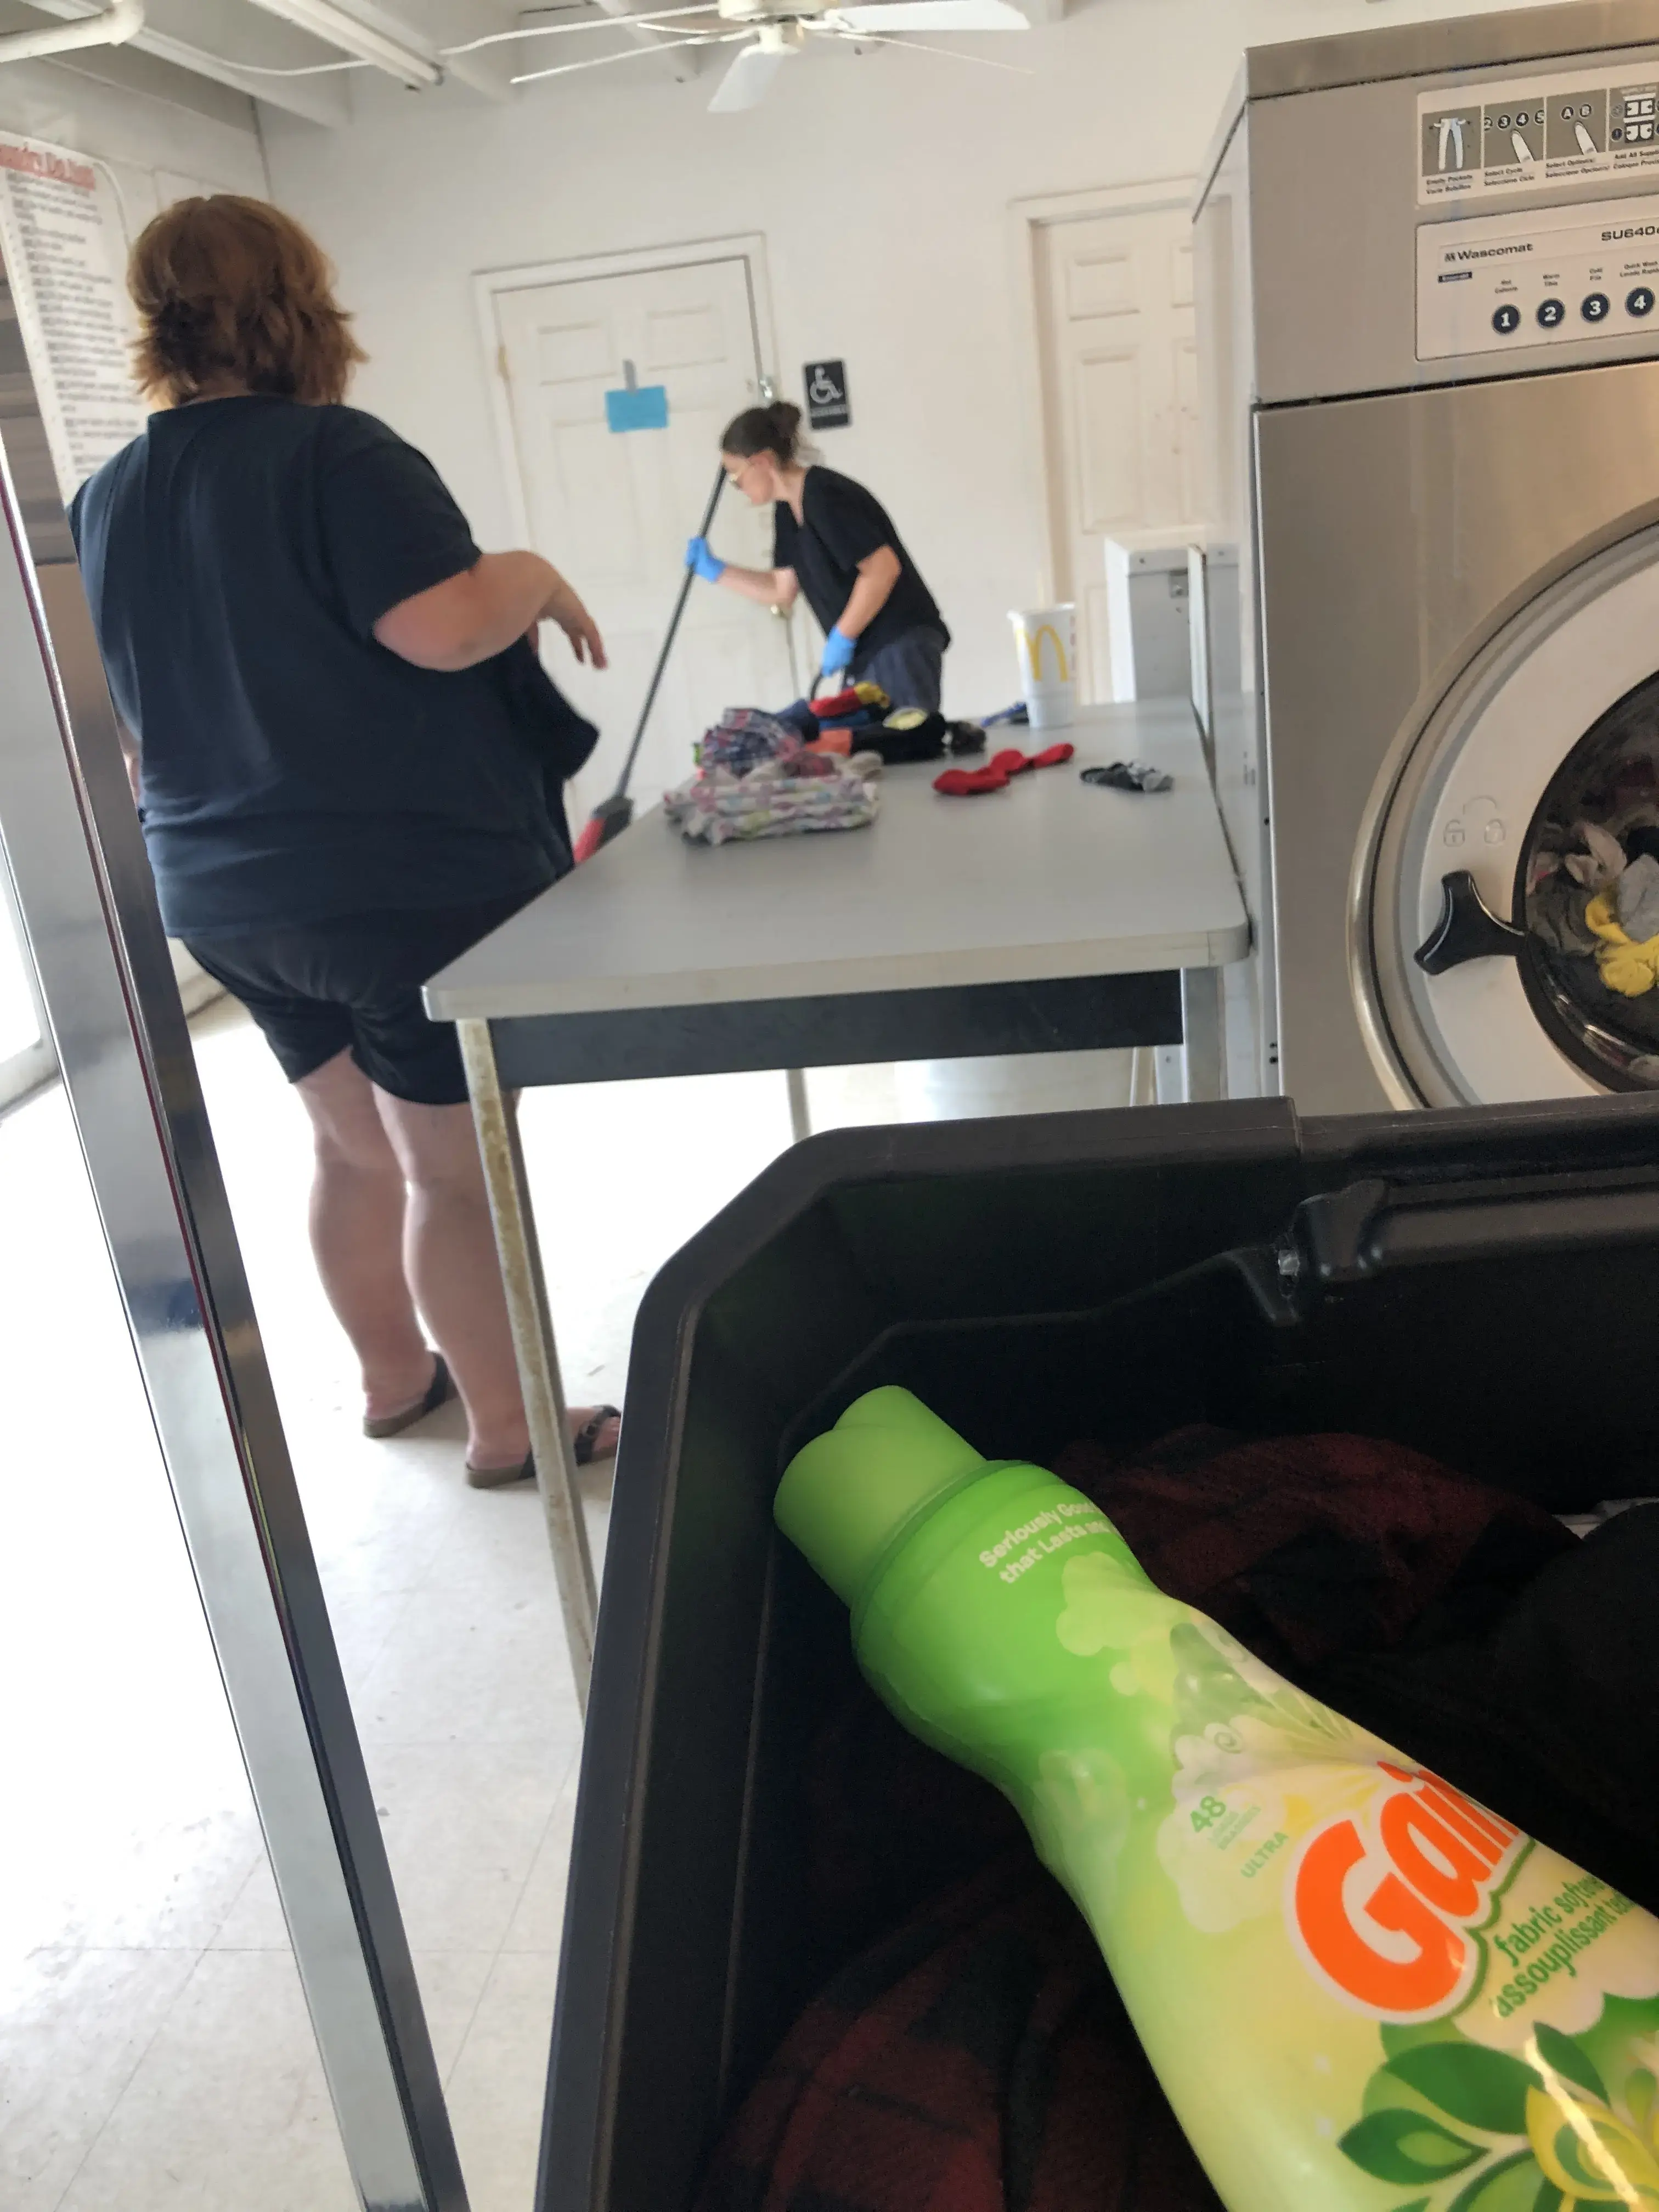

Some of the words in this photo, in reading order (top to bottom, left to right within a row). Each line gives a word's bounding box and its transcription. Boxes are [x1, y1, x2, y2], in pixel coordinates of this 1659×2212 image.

[1457, 242, 1534, 261] Wascomat
[1544, 306, 1557, 321] 2
[1589, 300, 1602, 315] 3
[1633, 294, 1646, 310] 4
[979, 1510, 1063, 1568] Seriously
[998, 1547, 1044, 1584] that
[1037, 1524, 1088, 1554] Lasts
[1189, 1795, 1227, 1833] 48
[1239, 1831, 1290, 1879] ULTRA
[1493, 1905, 1562, 1967] fabric
